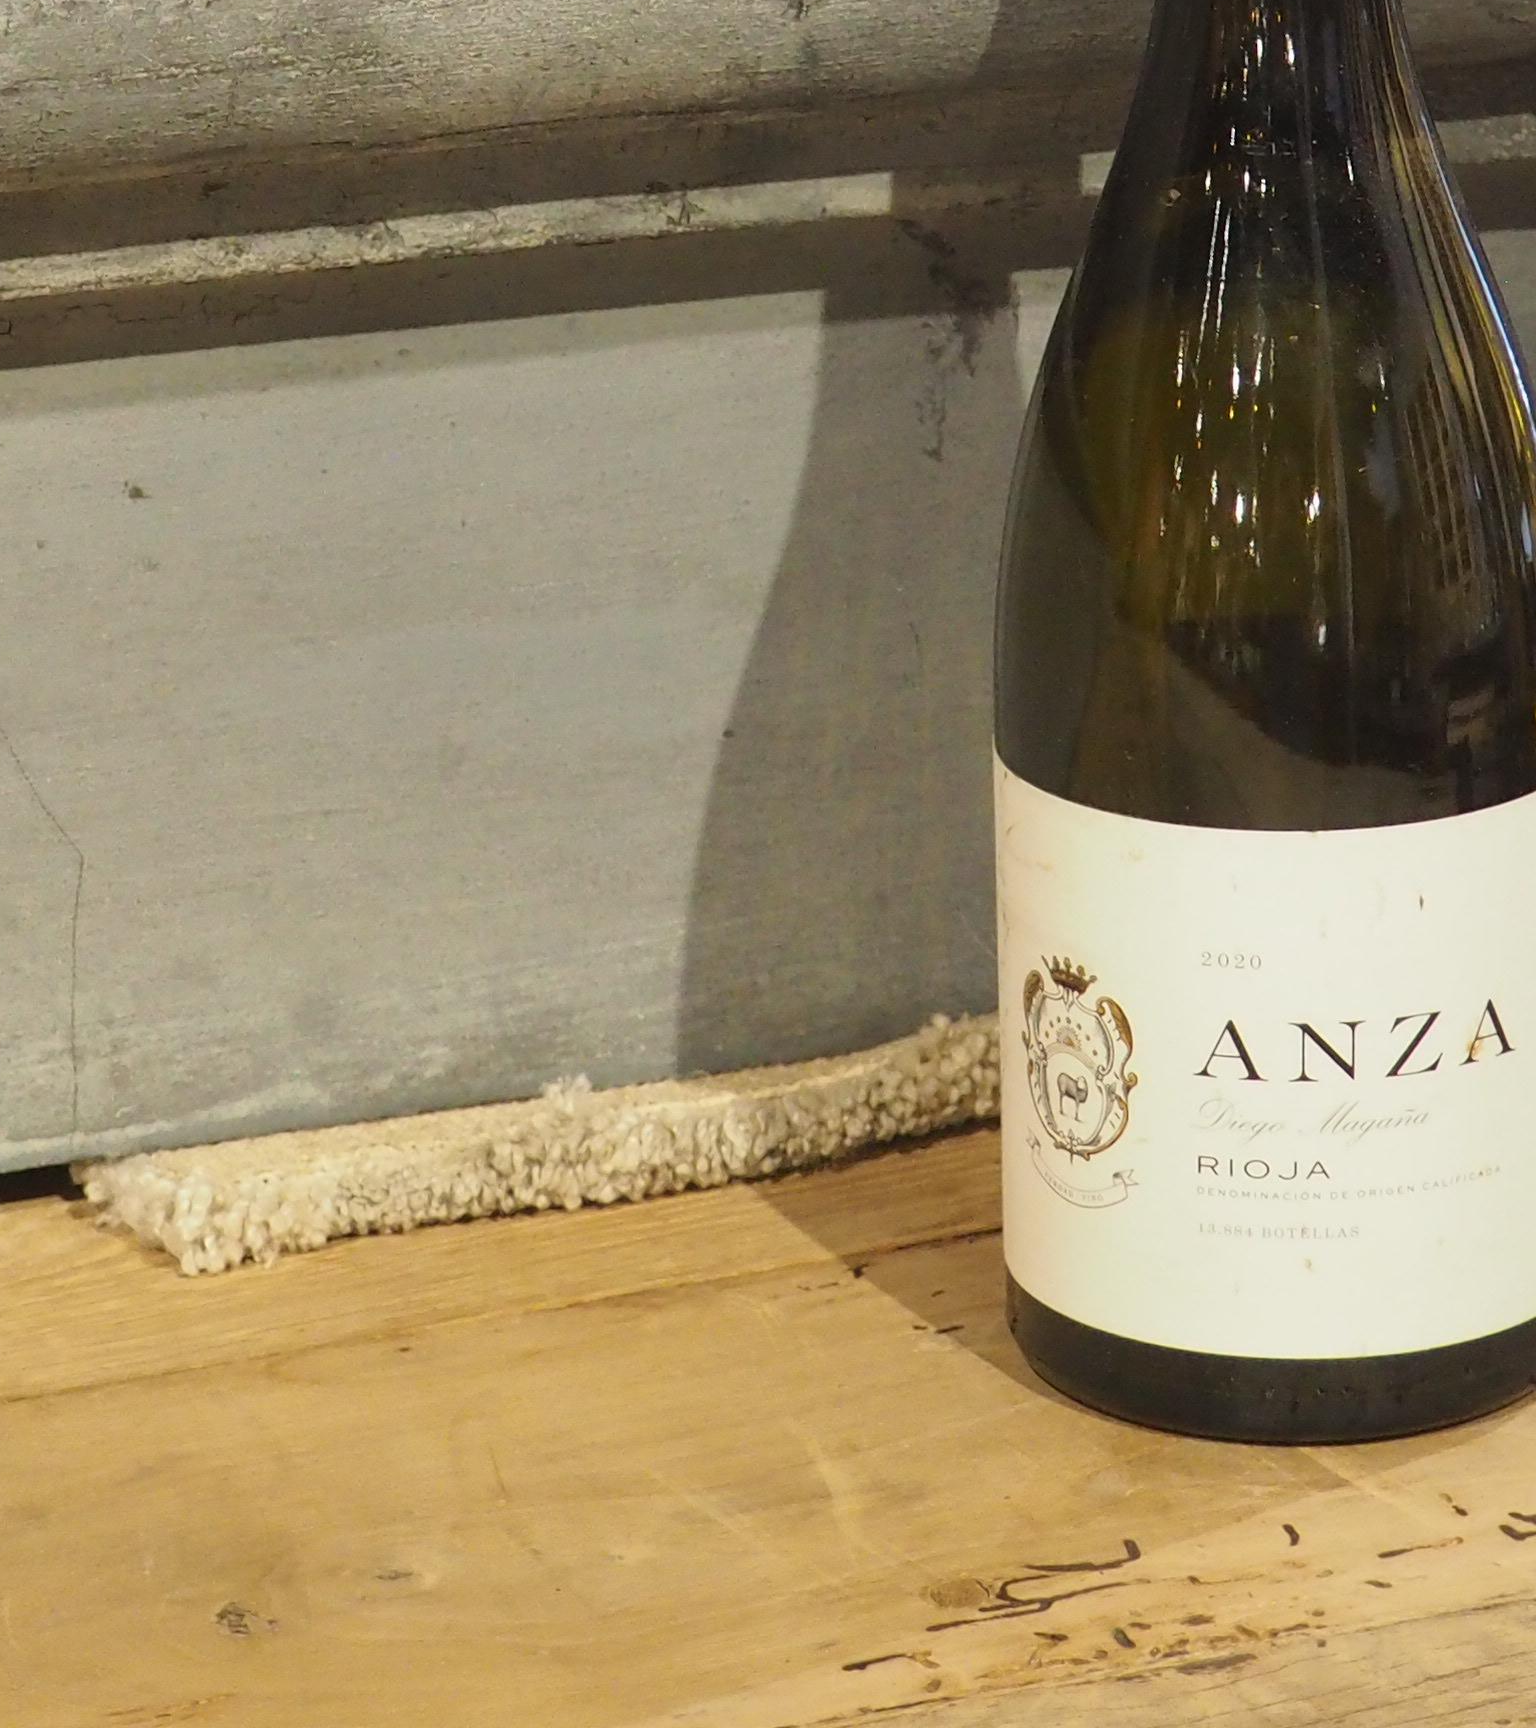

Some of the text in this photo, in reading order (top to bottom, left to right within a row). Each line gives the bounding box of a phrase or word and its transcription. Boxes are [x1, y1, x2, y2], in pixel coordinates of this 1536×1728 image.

[1200, 950, 1262, 970] 2020
[1193, 998, 1516, 1082] ANZA
[1191, 1097, 1430, 1148] Diego Magaña
[1196, 1155, 1331, 1180] RIOJA
[1329, 1189, 1350, 1201] DE
[1356, 1184, 1415, 1199] ORIGEN
